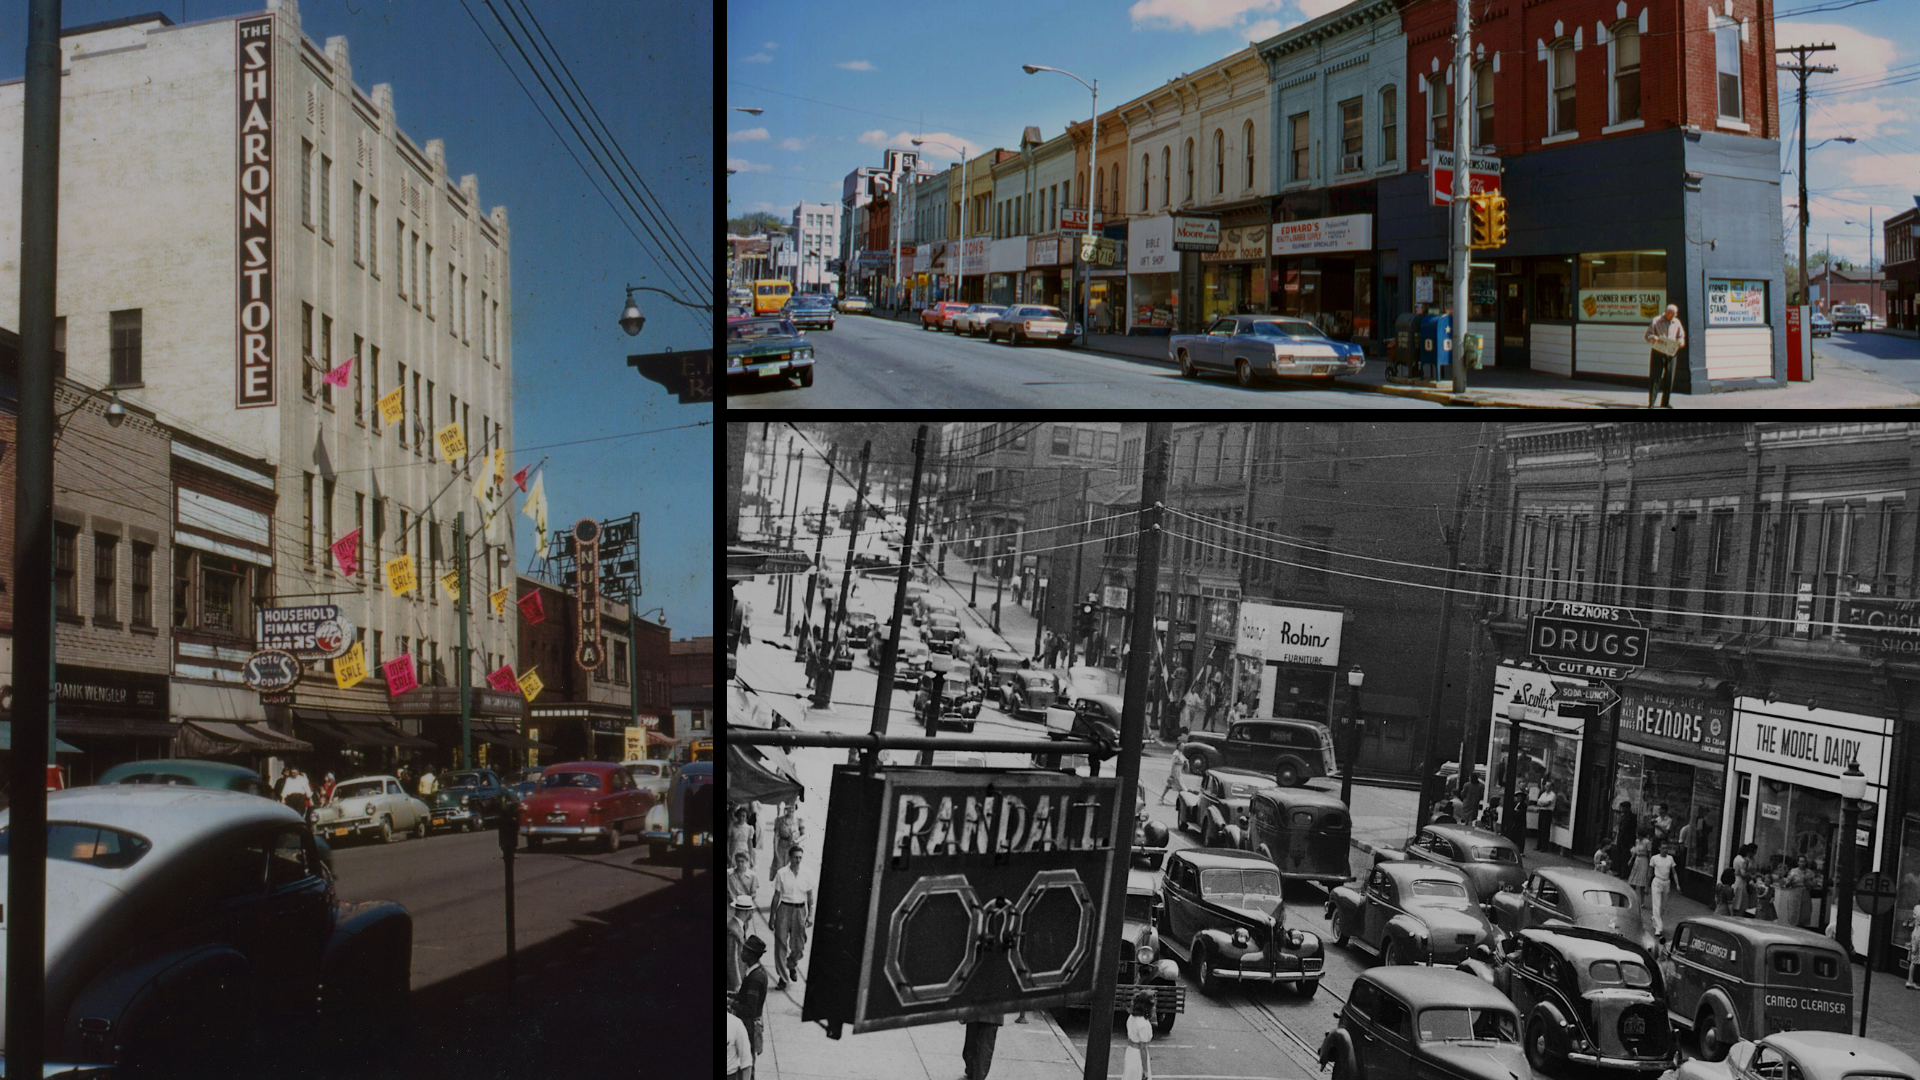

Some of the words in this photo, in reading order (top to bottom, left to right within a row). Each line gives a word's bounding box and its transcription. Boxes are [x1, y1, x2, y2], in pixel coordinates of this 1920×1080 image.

[241, 24, 271, 37] THE
[241, 40, 271, 229] SHARON
[1184, 221, 1205, 229] Benjamin
[1281, 222, 1319, 235] EDWARD'S
[1176, 226, 1204, 239] Moore
[1276, 233, 1289, 243] BEAUTY
[1292, 233, 1306, 242] BARBER
[1306, 232, 1322, 241] SUPPLY
[1145, 237, 1160, 249] BIBLE
[1184, 243, 1205, 251] DECORATOR
[1291, 242, 1312, 250] EQUIPMENT
[1313, 240, 1338, 249] SPECIALISTS
[1083, 249, 1096, 261] 62
[1100, 251, 1114, 263] 718
[1240, 246, 1263, 259] house
[1140, 256, 1150, 267] GIFT
[1152, 255, 1165, 266] SHOP
[1708, 284, 1728, 293] KORNER
[1595, 294, 1619, 303] KORNER
[1620, 294, 1637, 303] NEWS
[1639, 294, 1661, 303] STAND
[1711, 294, 1726, 304] NEWS
[1710, 304, 1728, 314] STAND
[241, 236, 271, 397] STORE
[439, 427, 457, 446] MAY
[445, 439, 465, 457] SALE
[389, 558, 409, 577] MAY
[392, 571, 412, 591] SALE
[264, 607, 336, 623] HOUSEHOLD
[1562, 603, 1620, 621] REZNOR'S
[264, 622, 316, 635] FINANCE
[1280, 621, 1330, 647] Robins
[264, 634, 316, 650] LOANS
[1538, 626, 1640, 657] DRUGS
[1284, 654, 1323, 665] FURNITURE
[340, 663, 362, 682] SALE
[388, 658, 410, 676] MAY
[1558, 662, 1584, 674] CUT
[1586, 665, 1618, 678] RATE
[392, 672, 413, 691] SALE
[524, 679, 540, 697] SALE
[54, 682, 84, 700] RANK
[84, 684, 127, 703] WENGLER
[1625, 696, 1635, 706] CUT
[1680, 696, 1695, 709] SAVE
[1622, 708, 1635, 719] RATE
[1619, 718, 1636, 730] DRUGS
[1636, 705, 1703, 742] REZNORS
[1757, 723, 1778, 753] THE
[1780, 728, 1819, 763] MODEL
[1823, 736, 1861, 768] DAIRY
[1864, 877, 1874, 891] R
[1880, 879, 1890, 892] R
[1691, 938, 1705, 952] CAMEO
[1705, 942, 1729, 959] CLEANSER
[1764, 994, 1798, 1009] CAMEO
[1800, 998, 1846, 1015] CLEANSER
